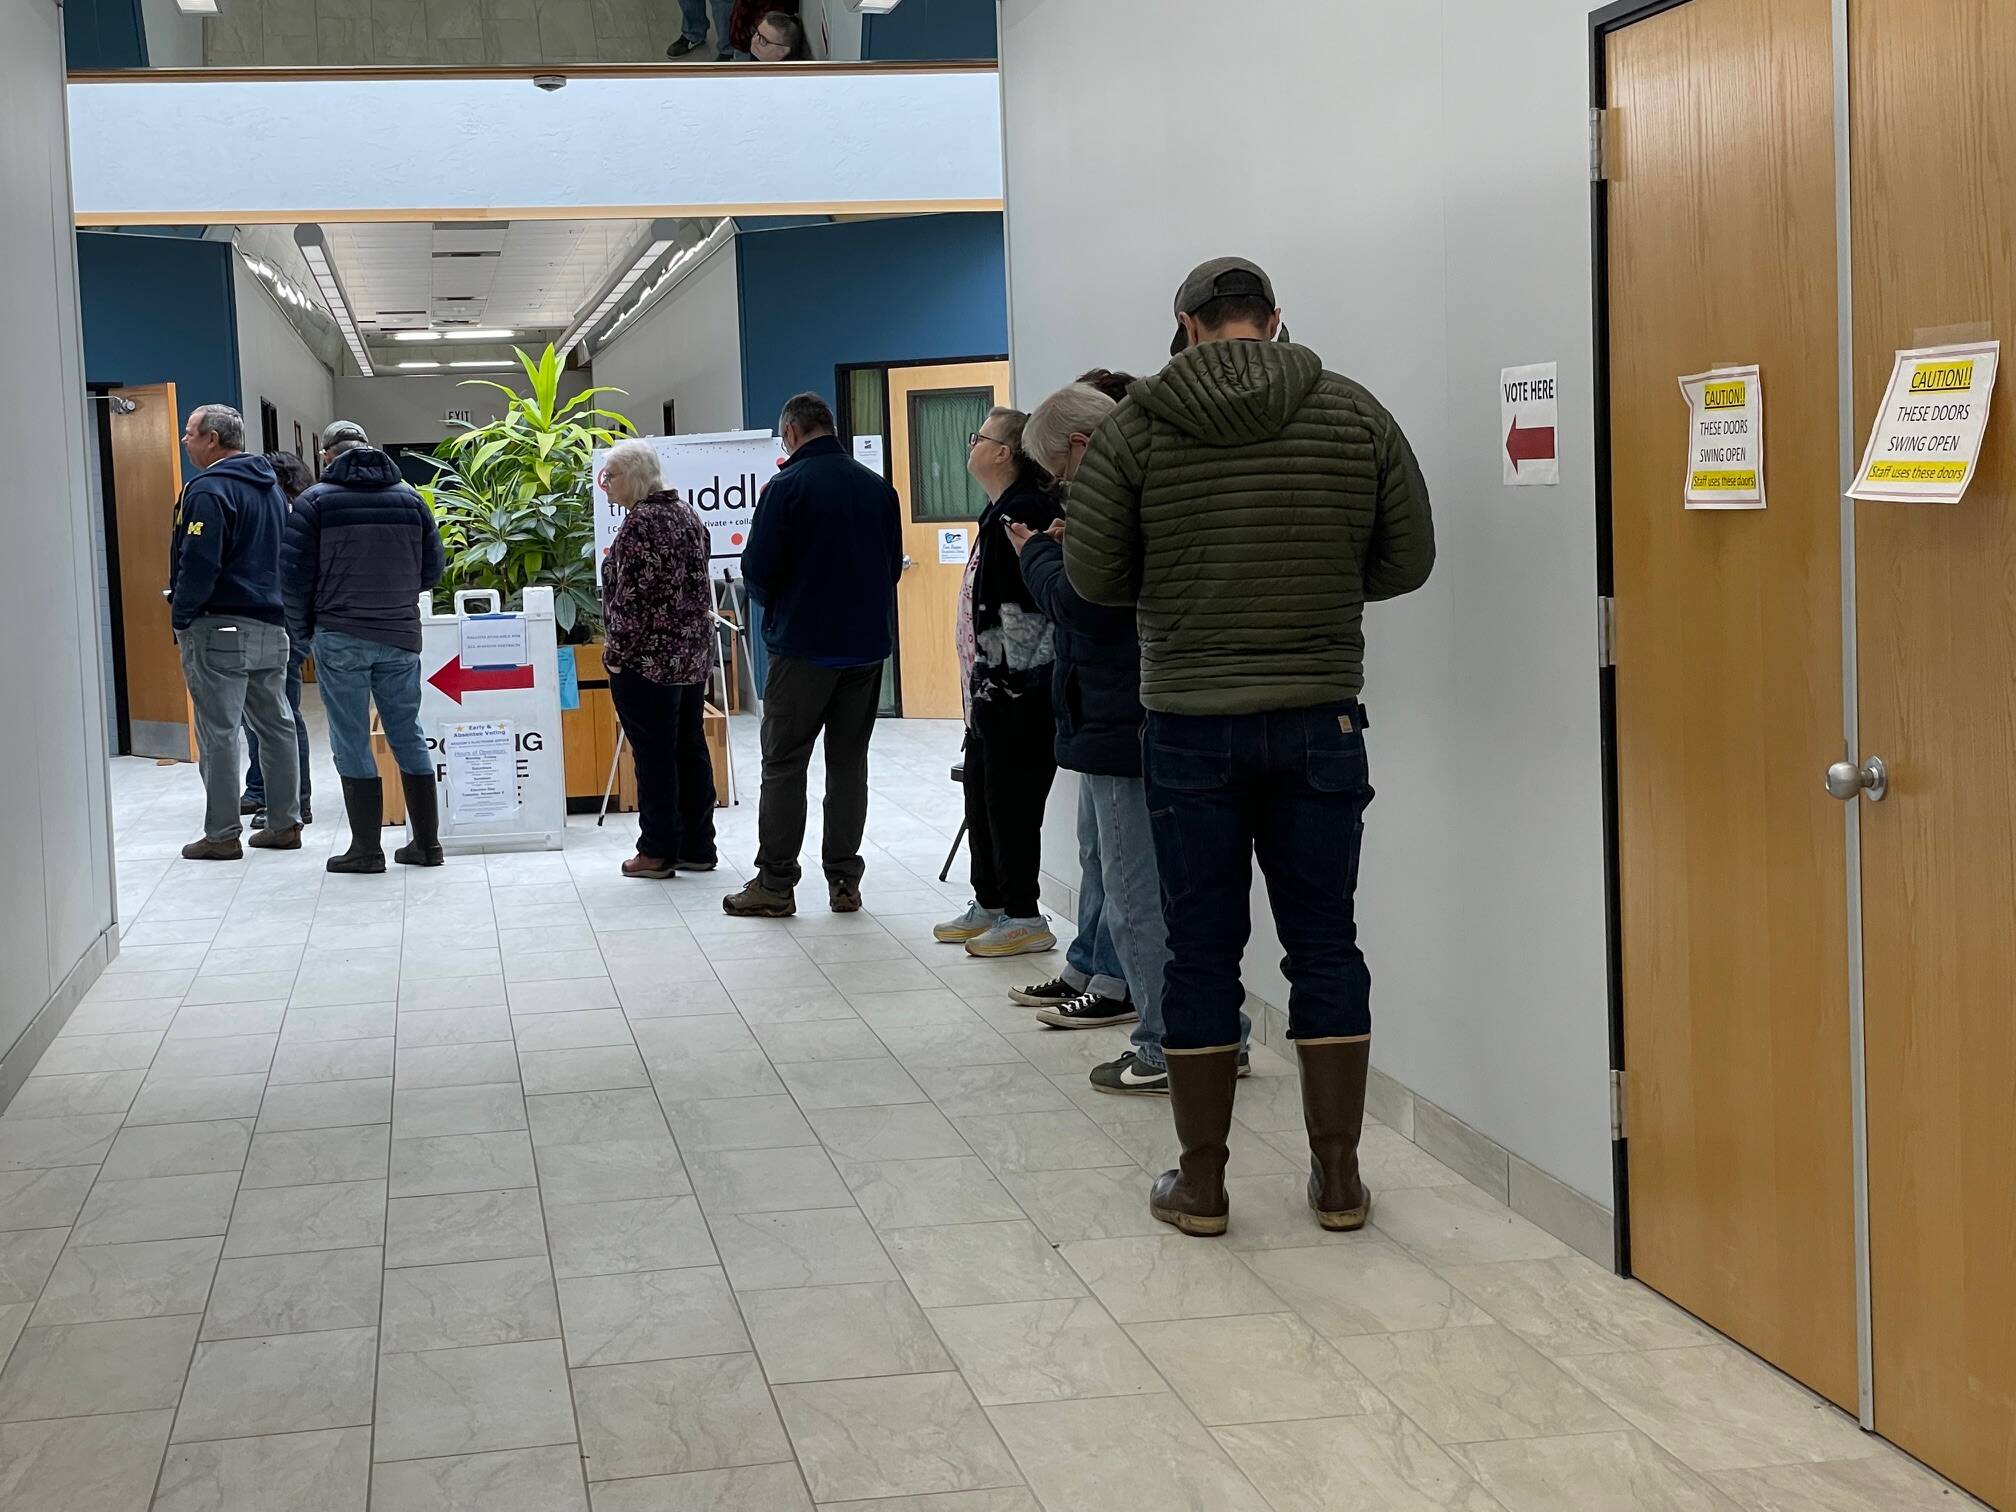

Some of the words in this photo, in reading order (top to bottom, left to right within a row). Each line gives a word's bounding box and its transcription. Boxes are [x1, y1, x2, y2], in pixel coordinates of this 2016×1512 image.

[1911, 366, 1973, 389] CAUTION!!
[1504, 381, 1528, 403] VOTE
[1530, 379, 1554, 400] HERE
[1704, 387, 1745, 407] CAUTION!!
[448, 410, 470, 422] EXIT
[1897, 405, 1931, 422] THESE
[1931, 404, 1971, 421] DOORS
[1700, 421, 1722, 436] THESE
[1723, 419, 1748, 434] DOORS
[1887, 436, 1928, 452] SWING
[1927, 435, 1961, 452] OPEN
[1699, 449, 1724, 463] SWING
[1725, 447, 1746, 462] OPEN
[1891, 468, 1911, 479] uses
[1911, 466, 1936, 479] these
[1707, 477, 1721, 487] uses
[1721, 475, 1737, 487] these
[187, 521, 204, 536] M
[468, 724, 485, 732] Early
[484, 729, 506, 737] Voting
